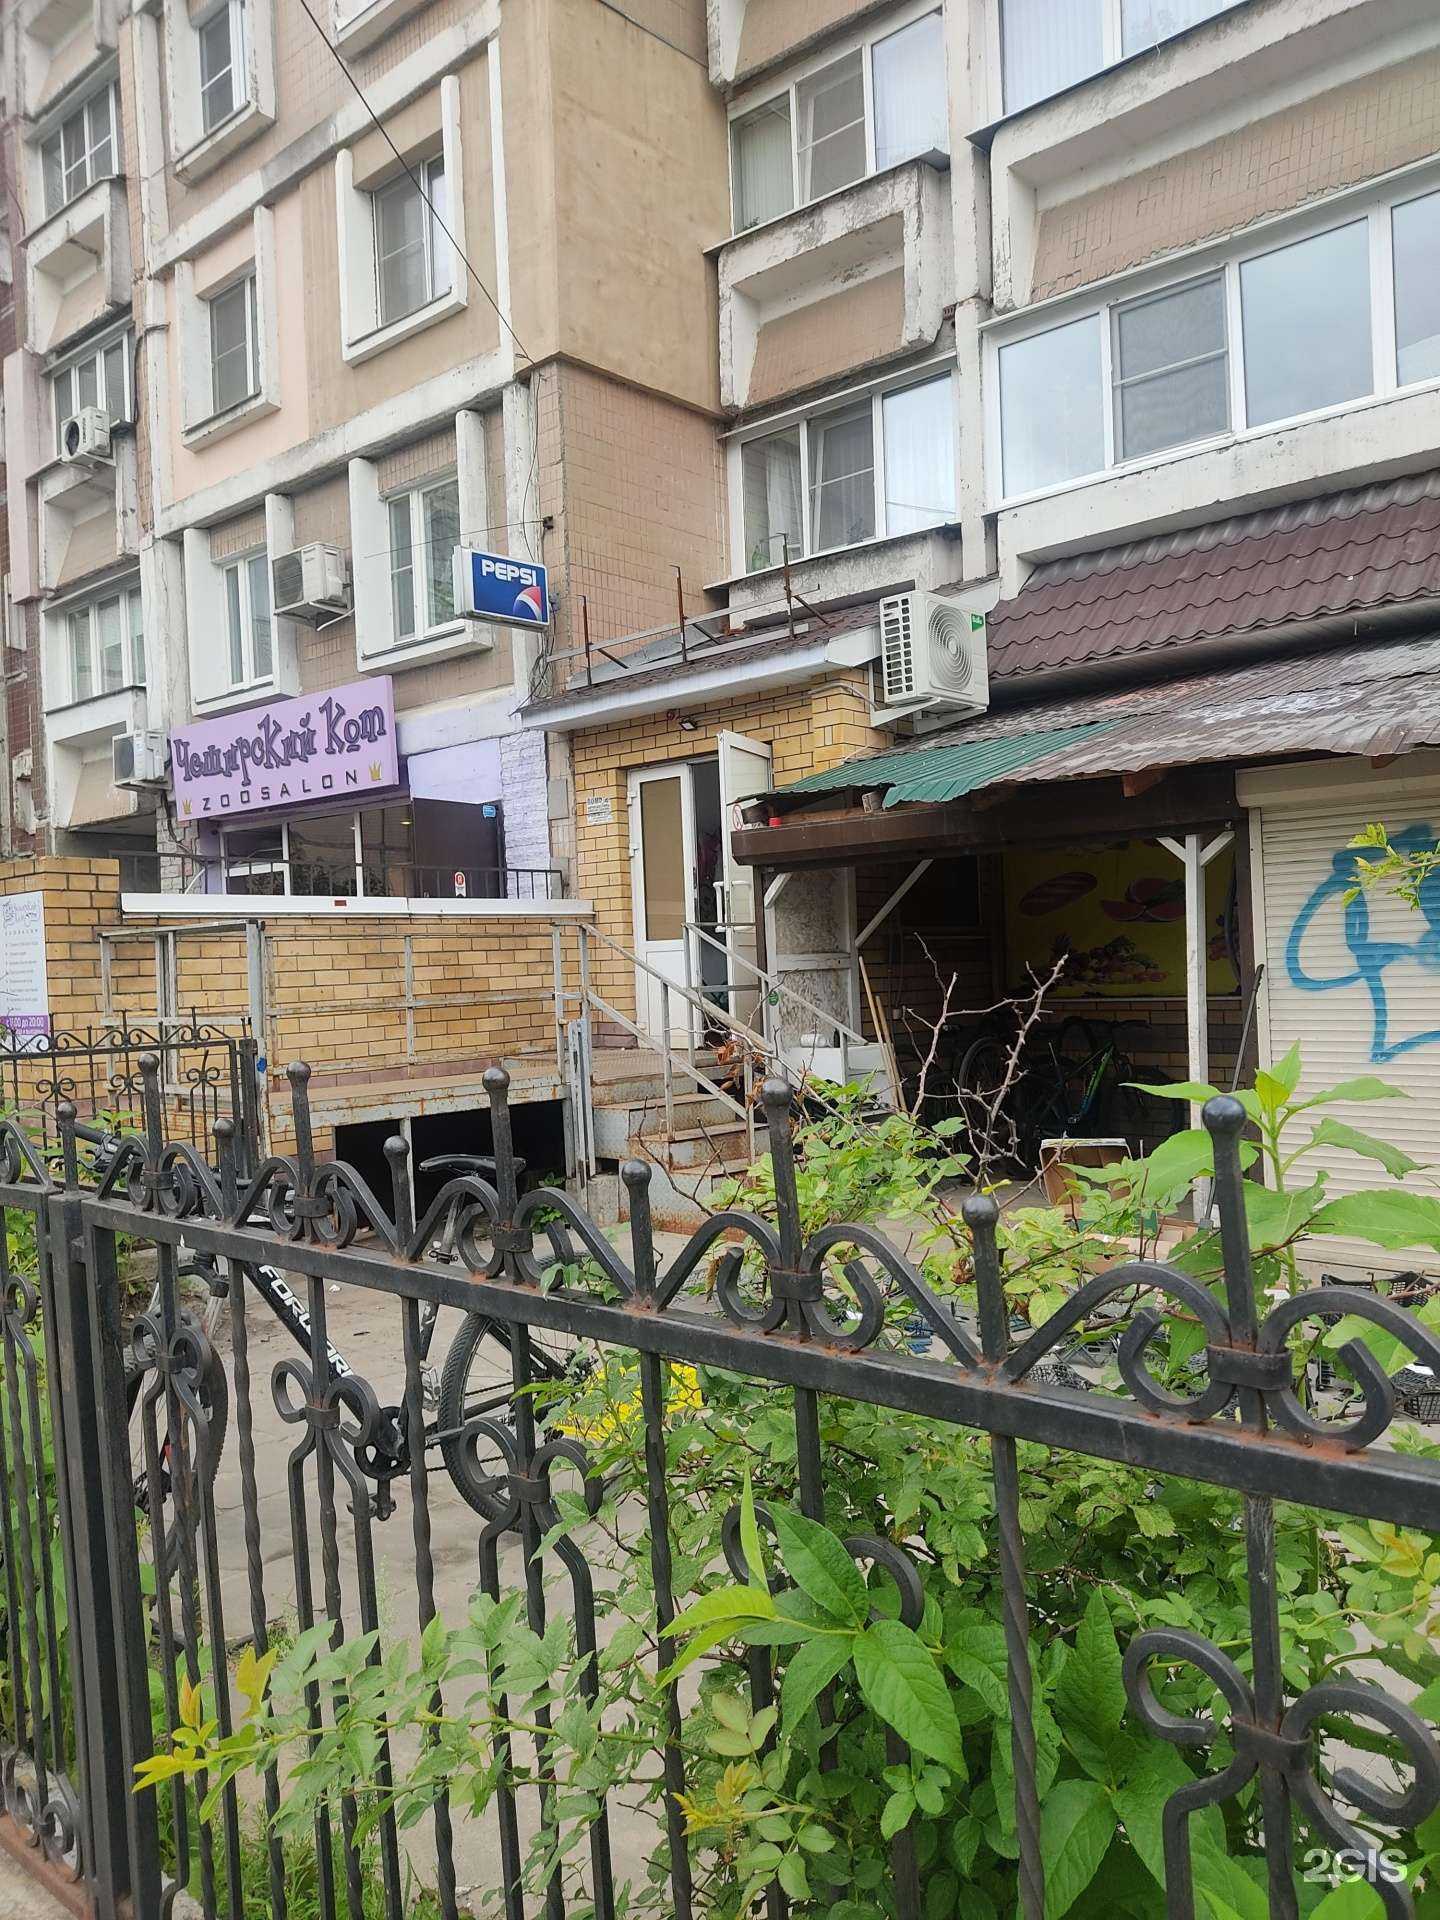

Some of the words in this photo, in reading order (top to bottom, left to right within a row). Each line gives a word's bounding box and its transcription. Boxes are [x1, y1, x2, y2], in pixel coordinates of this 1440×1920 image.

[481, 559, 537, 586] PEPSI
[319, 697, 387, 755] Кот
[202, 769, 359, 811] ZOOSALON
